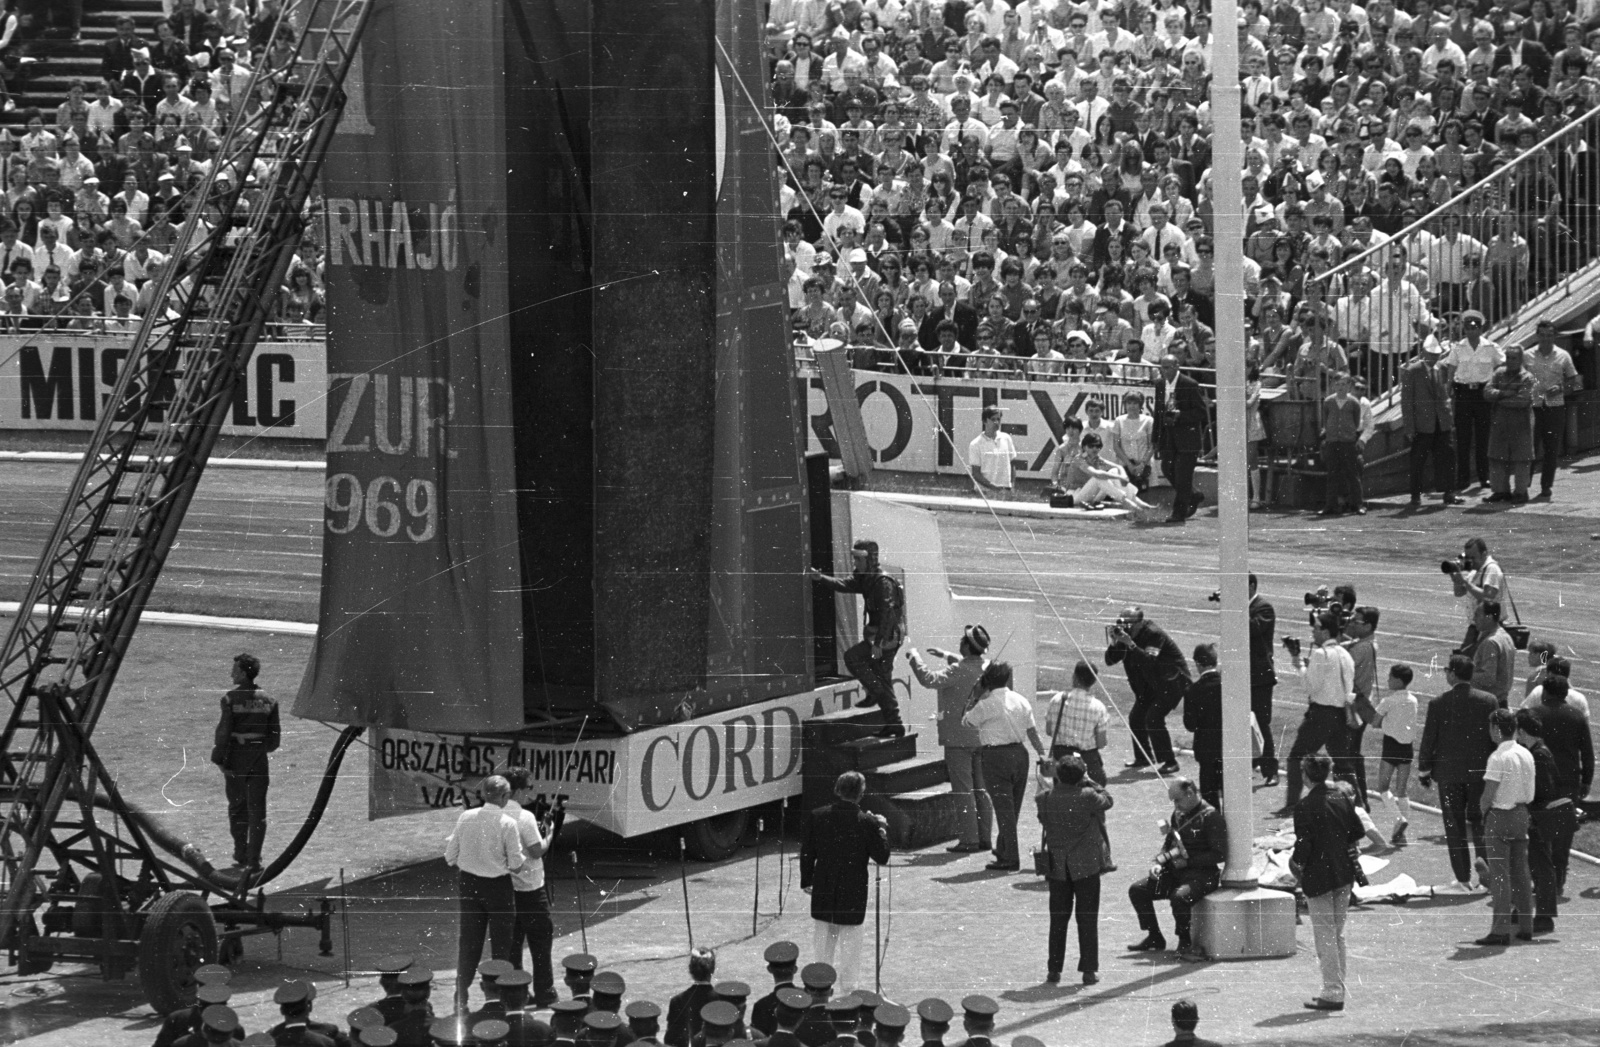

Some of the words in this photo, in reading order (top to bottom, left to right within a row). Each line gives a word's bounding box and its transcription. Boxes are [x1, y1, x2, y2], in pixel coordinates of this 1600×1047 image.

[20, 345, 296, 428] MISKLC
[325, 473, 437, 542] 969
[382, 737, 496, 777] ORSZÁGOS
